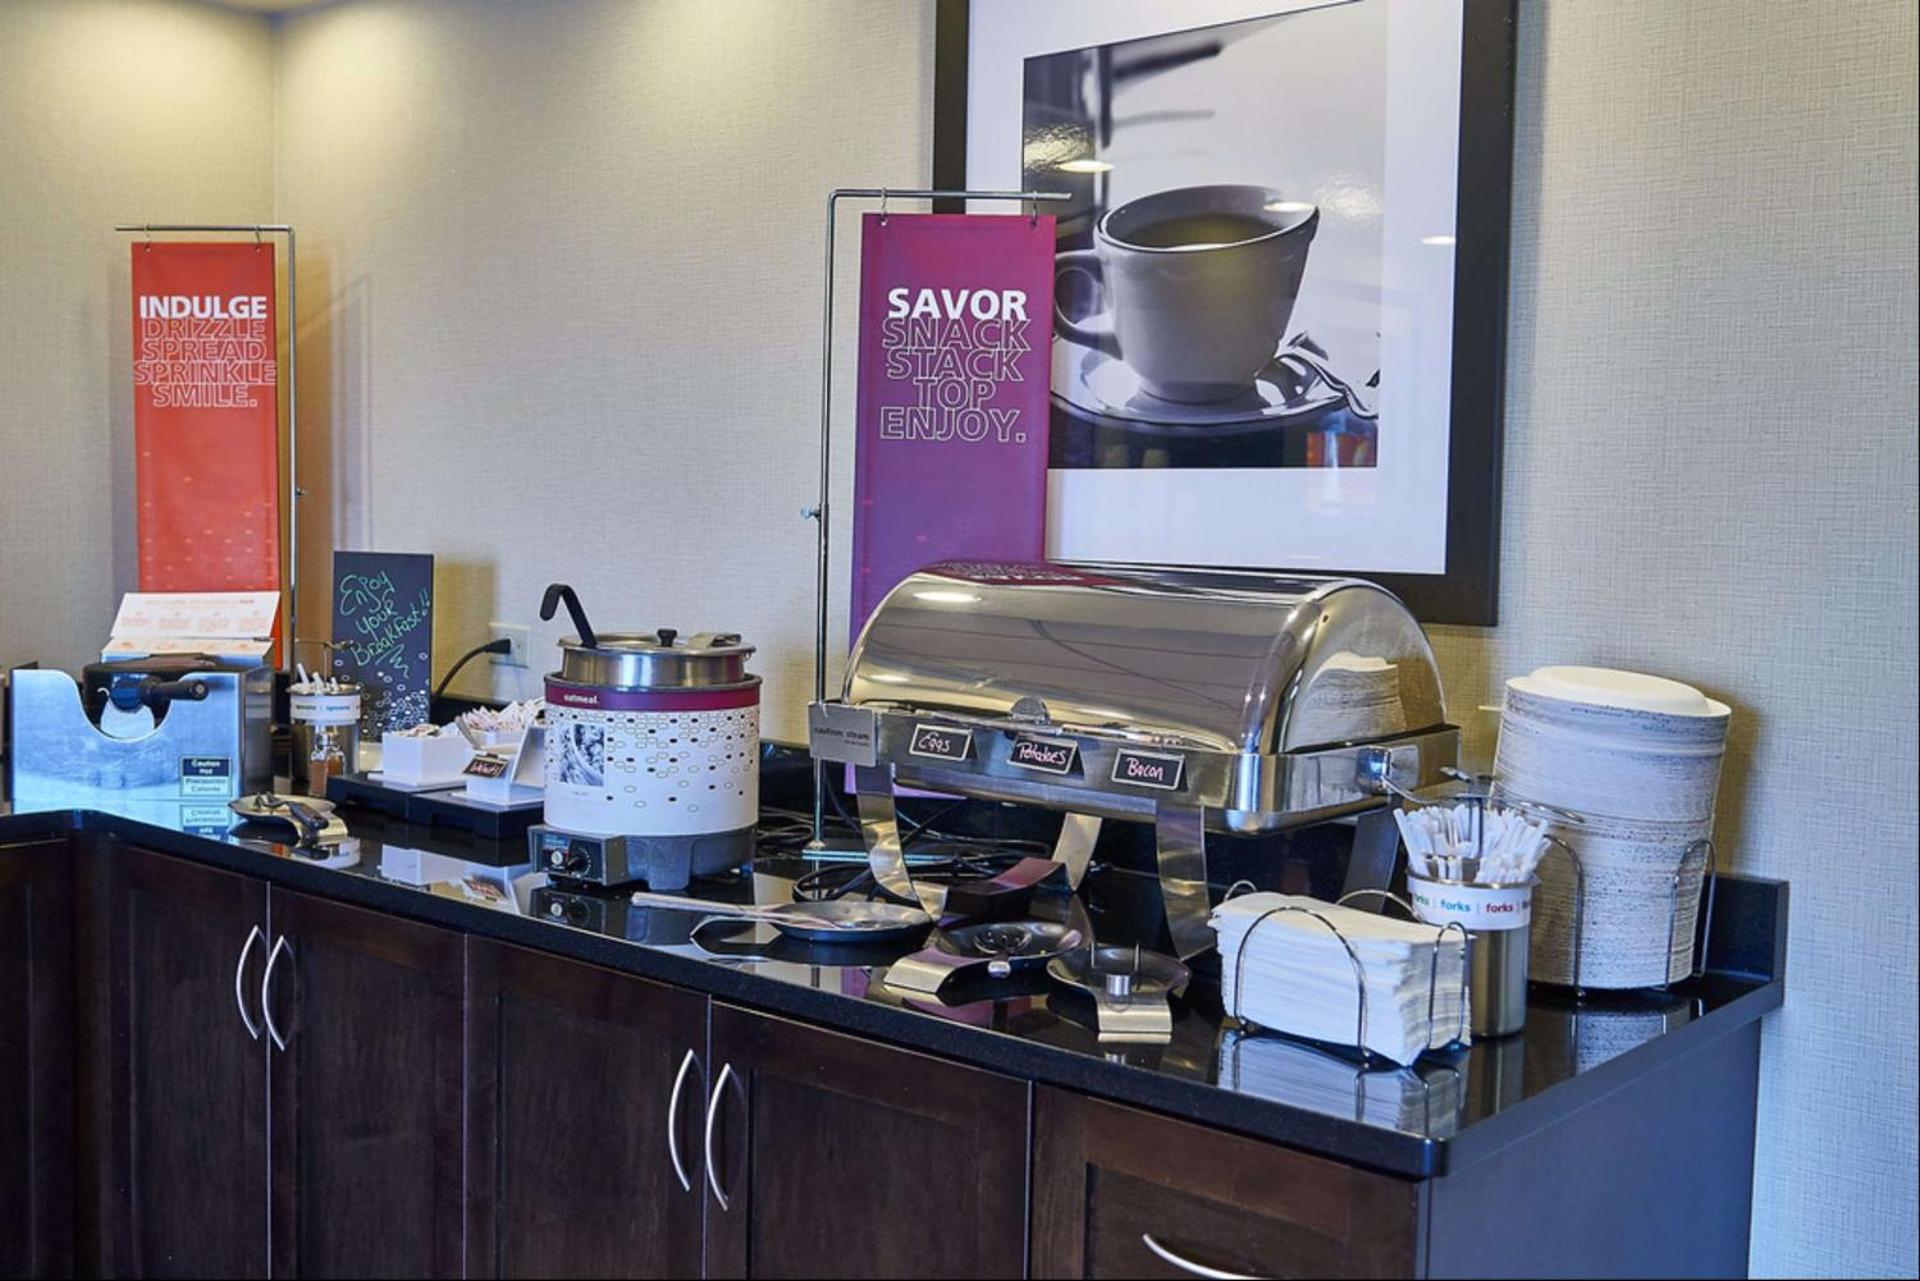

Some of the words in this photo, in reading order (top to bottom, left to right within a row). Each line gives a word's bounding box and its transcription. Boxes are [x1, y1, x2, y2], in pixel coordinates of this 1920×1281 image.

[139, 296, 268, 319] INDULGE
[888, 288, 1027, 321] SAVOR
[142, 318, 266, 340] DRIZZLE
[882, 318, 1031, 351] SNACK
[142, 338, 268, 362] SPREAD
[133, 360, 278, 385] SPRINKLE
[887, 346, 1025, 381] STACK
[152, 383, 258, 408] SMILE.
[913, 377, 996, 411] TOP
[880, 406, 1027, 443] ENJOY.
[1126, 757, 1164, 782] Bacon
[1440, 899, 1472, 913] forks
[1486, 902, 1514, 914] forks
